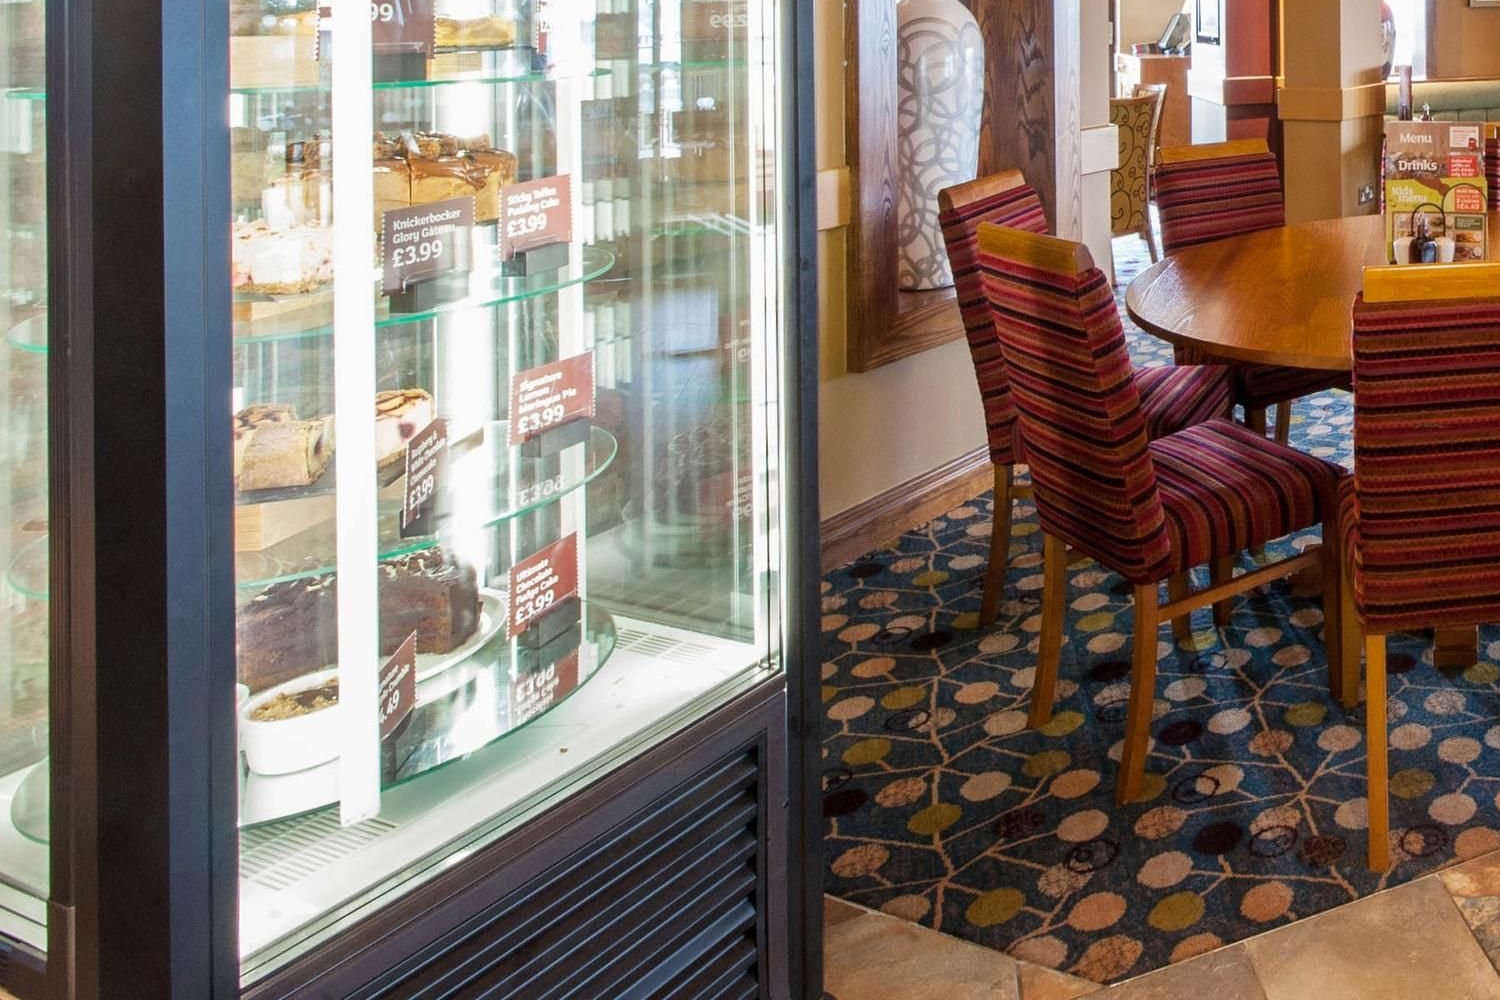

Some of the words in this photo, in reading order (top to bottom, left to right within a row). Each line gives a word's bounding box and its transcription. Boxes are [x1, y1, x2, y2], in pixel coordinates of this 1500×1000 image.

[1400, 132, 1432, 144] Menu
[1398, 160, 1438, 171] Drinks
[1392, 186, 1414, 196] Kids
[1398, 194, 1427, 203] menu
[393, 209, 461, 231] Knickerbocker
[507, 212, 548, 238] £3.99
[393, 231, 420, 244] Glory
[392, 240, 443, 268] £3.99
[518, 404, 565, 434] £3.99
[410, 473, 434, 511] £3.99
[516, 558, 549, 583] Ultimate
[516, 567, 553, 594] Chocolate
[540, 574, 560, 592] Cake
[515, 588, 555, 626] £3.99
